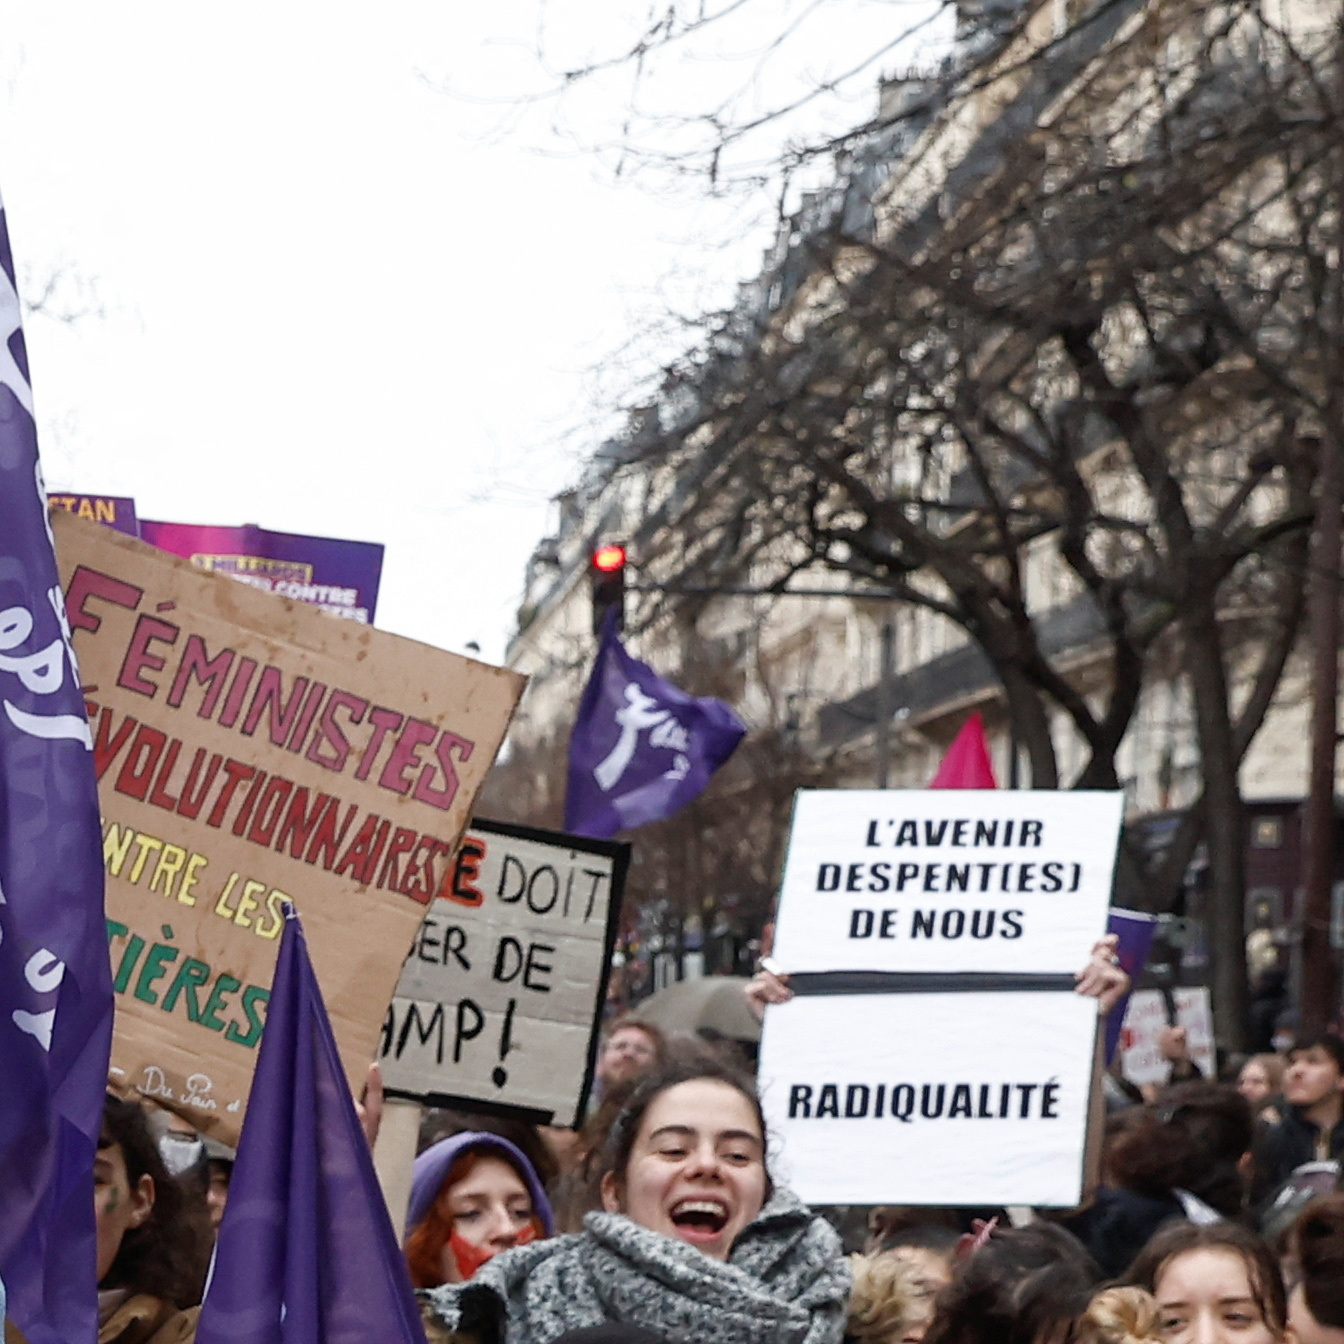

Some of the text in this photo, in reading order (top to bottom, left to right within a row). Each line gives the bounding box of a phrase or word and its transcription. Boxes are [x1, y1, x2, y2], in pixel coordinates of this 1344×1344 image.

[62, 565, 476, 810] FÉMINISTES
[865, 818, 1044, 848] L'AVENIR
[100, 820, 296, 941] NTRE LES
[848, 908, 1025, 939] DE NOUS
[492, 936, 555, 993] DE
[787, 1074, 1061, 1124] RADIQUALITÉ
